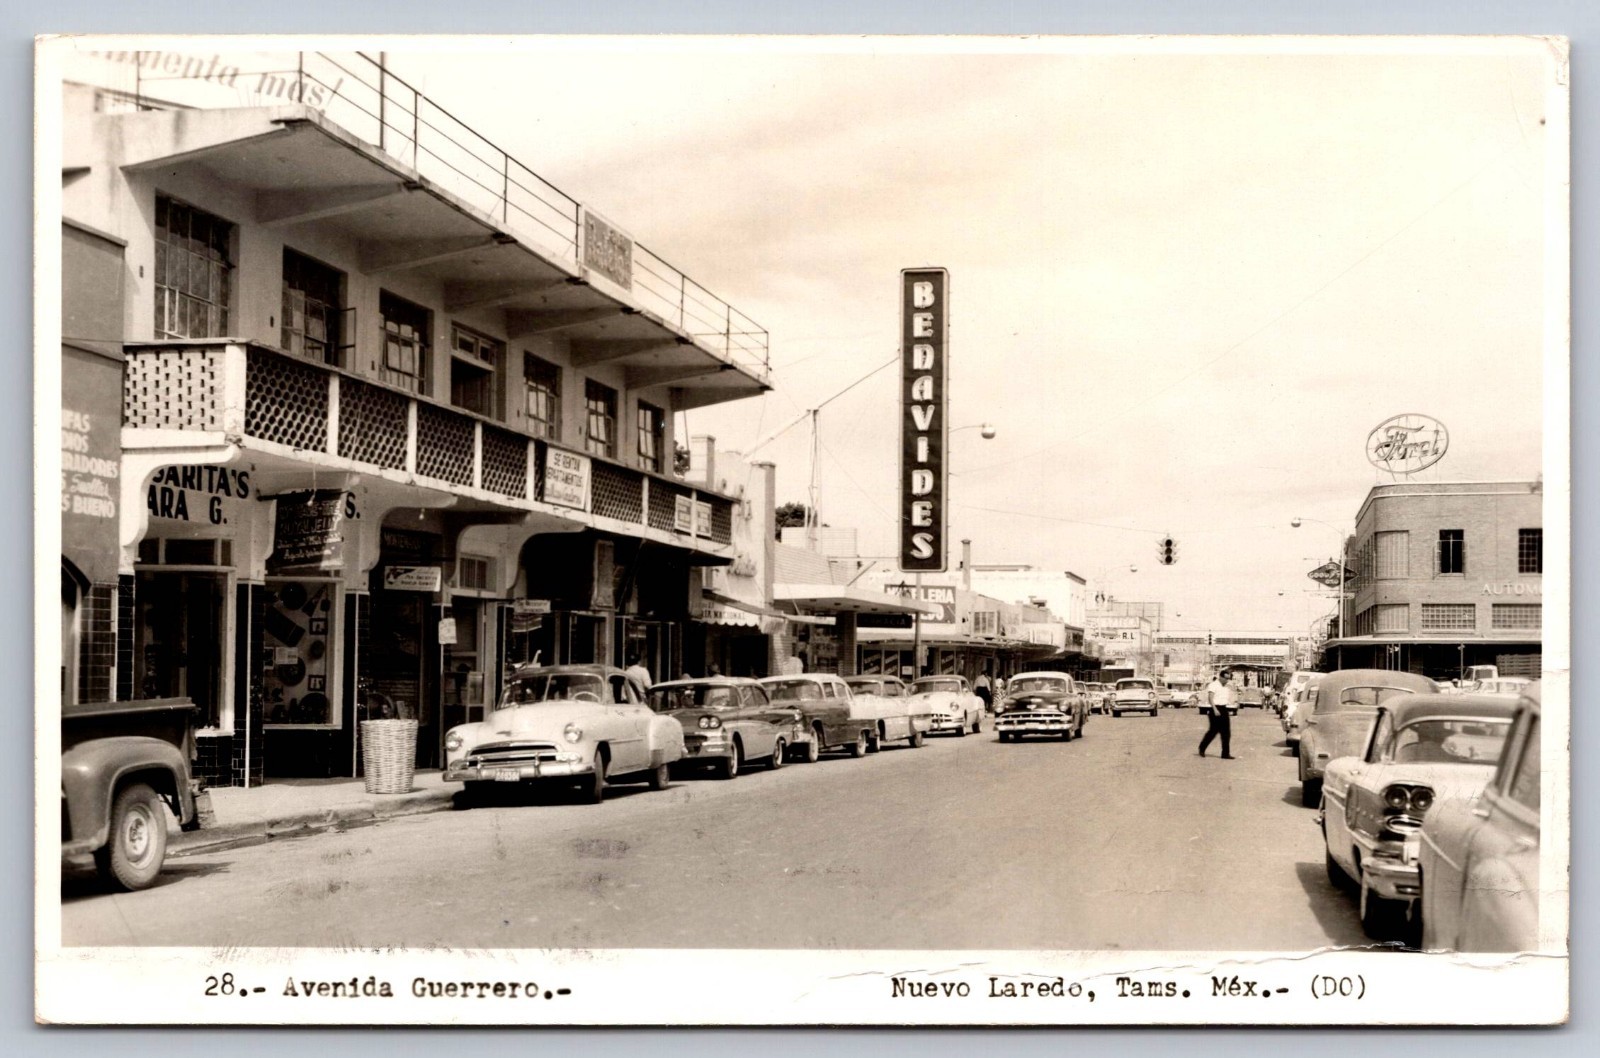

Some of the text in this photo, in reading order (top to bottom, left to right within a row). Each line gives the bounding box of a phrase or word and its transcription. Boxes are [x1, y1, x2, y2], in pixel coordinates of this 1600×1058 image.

[1374, 424, 1440, 461] Ford
[73, 495, 116, 518] BUENO
[209, 496, 228, 525] G.
